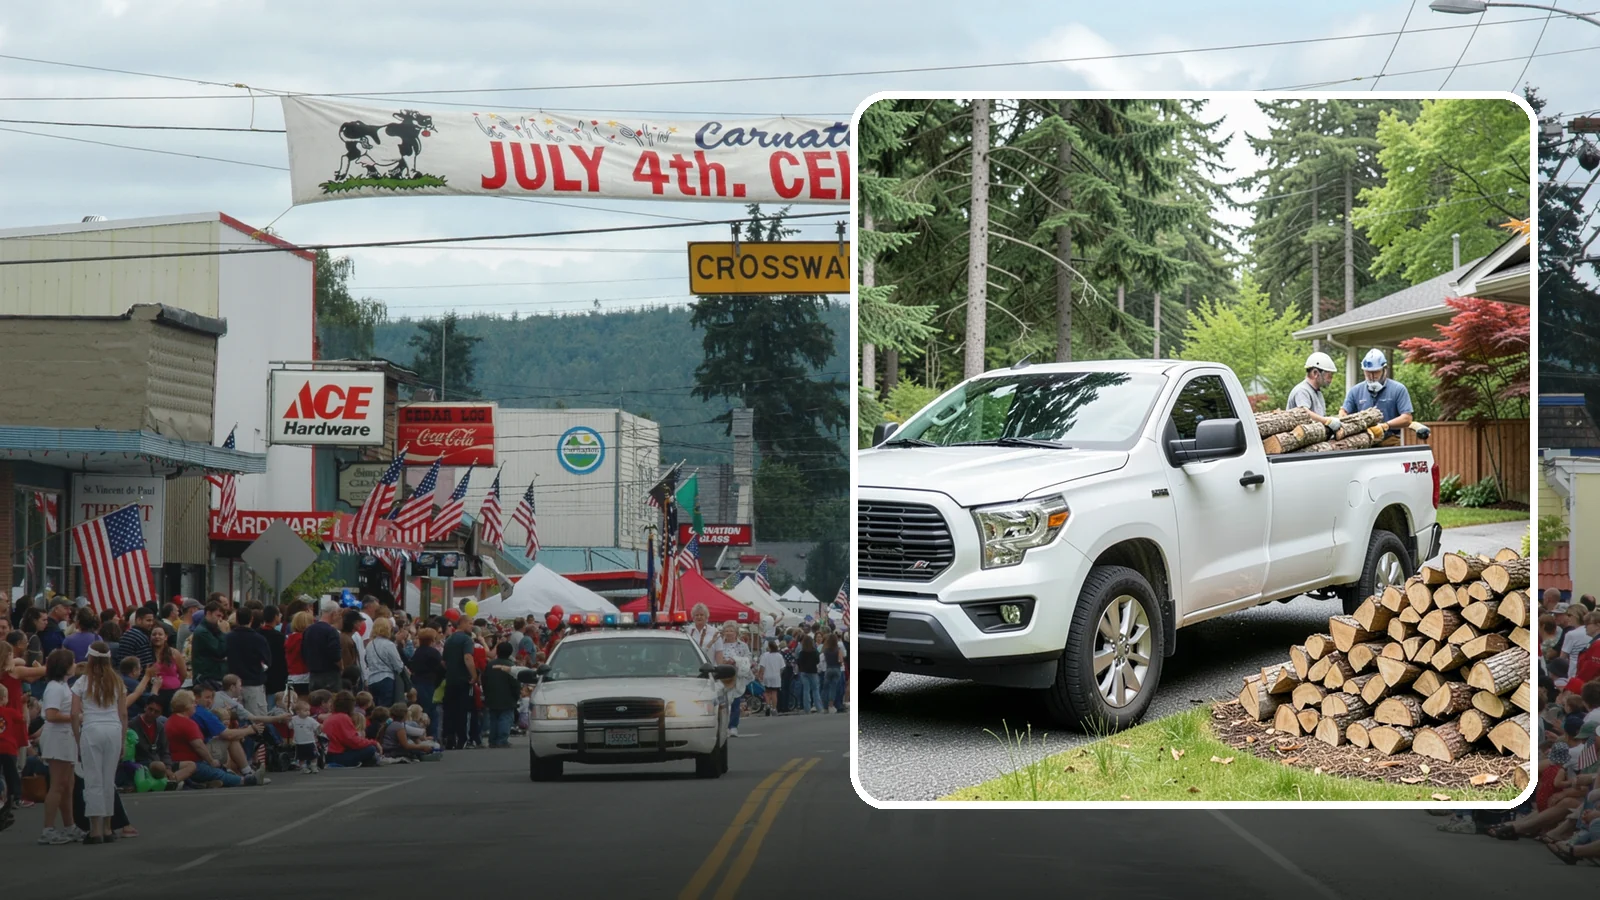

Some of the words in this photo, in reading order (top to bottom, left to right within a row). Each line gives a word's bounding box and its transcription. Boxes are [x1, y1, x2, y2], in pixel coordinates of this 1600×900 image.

[481, 141, 605, 193] JULY
[632, 149, 746, 198] 4th.
[697, 254, 850, 280] CROSSWA
[282, 380, 374, 420] ACE
[406, 409, 453, 422] CEDAR
[461, 409, 485, 422] LOG
[283, 421, 371, 437] Hardware
[416, 428, 477, 447] Coca-Cola
[353, 467, 386, 480] Simpl
[96, 485, 125, 495] Vincent
[126, 486, 135, 495] de
[137, 486, 155, 495] Paul
[212, 516, 331, 535] HARDARE
[688, 526, 741, 535] CRNATION
[699, 535, 730, 543] GLASS
